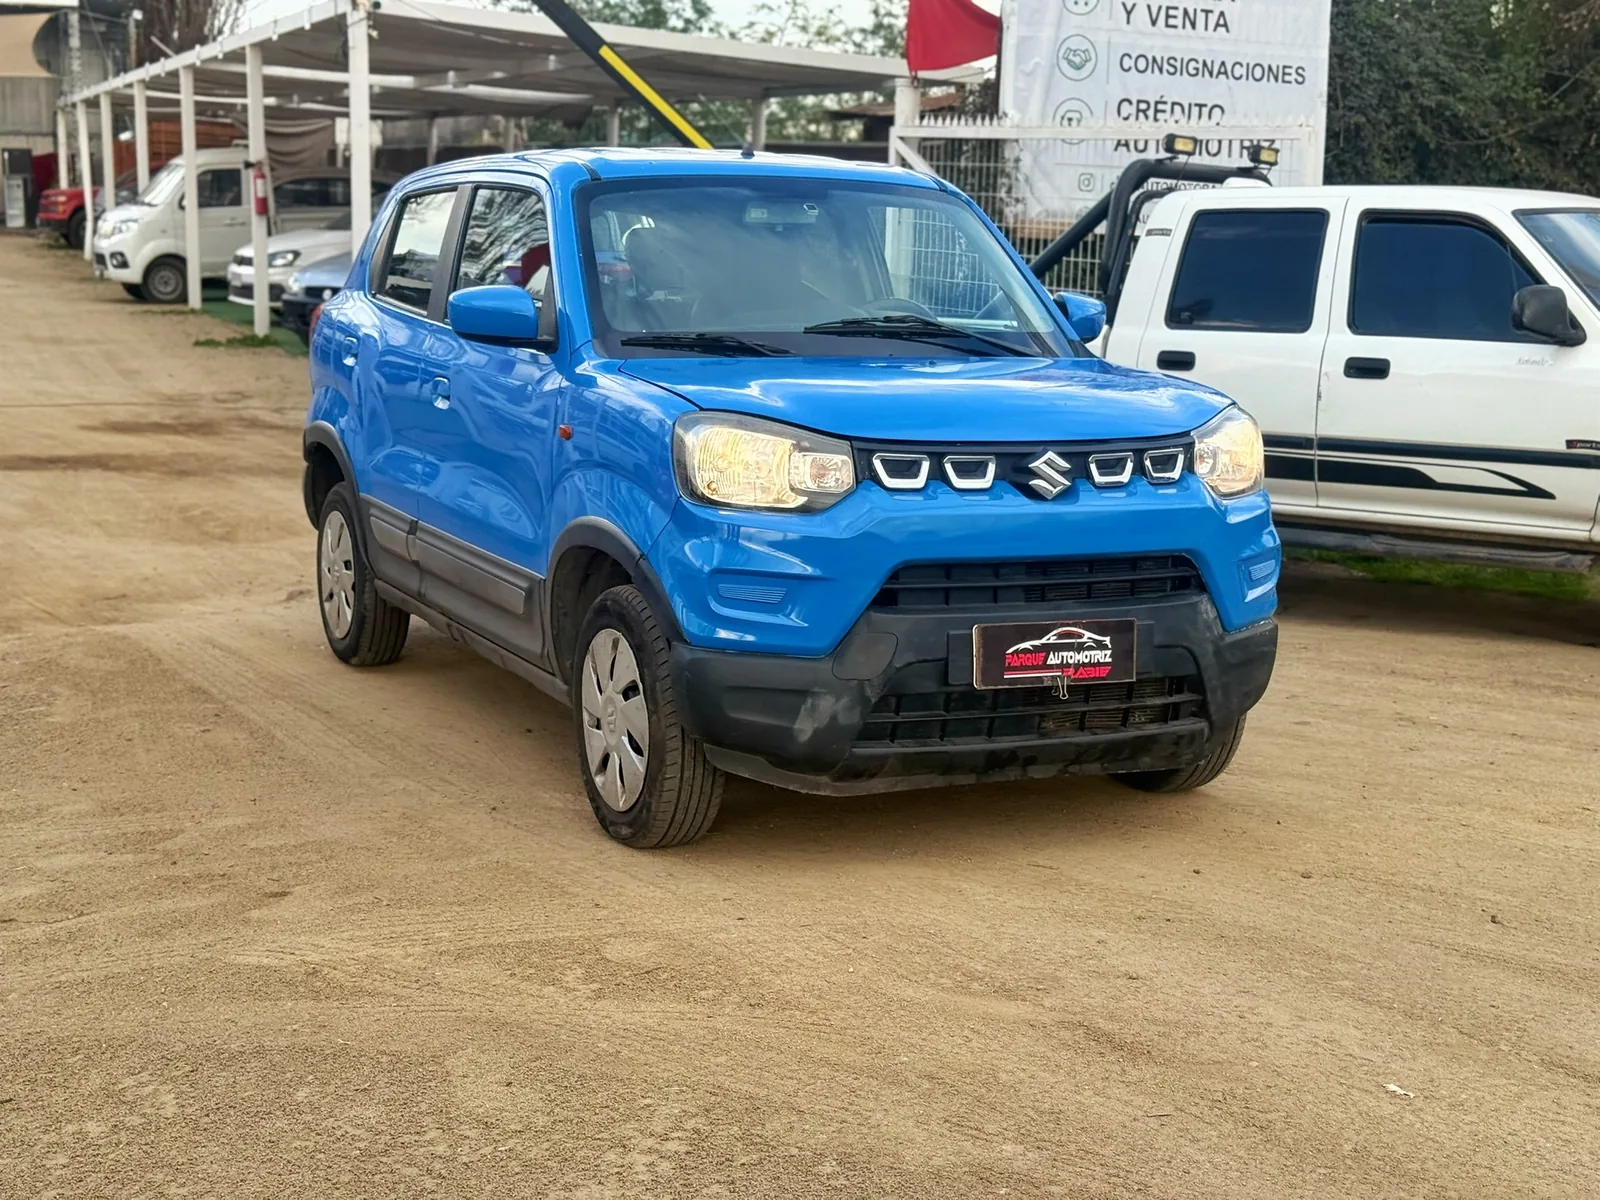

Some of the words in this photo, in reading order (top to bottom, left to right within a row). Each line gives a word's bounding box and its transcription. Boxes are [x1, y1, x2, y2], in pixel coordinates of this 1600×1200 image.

[1121, 1, 1137, 25] Y
[1147, 4, 1230, 33] VENTA
[1119, 53, 1306, 85] CONSIGNACIONES
[1117, 95, 1225, 126] CRÉDITO
[1114, 139, 1276, 158] AUTOTR
[1005, 652, 1046, 666] PARQUE
[1046, 650, 1112, 665] AUTOMOTRIZ
